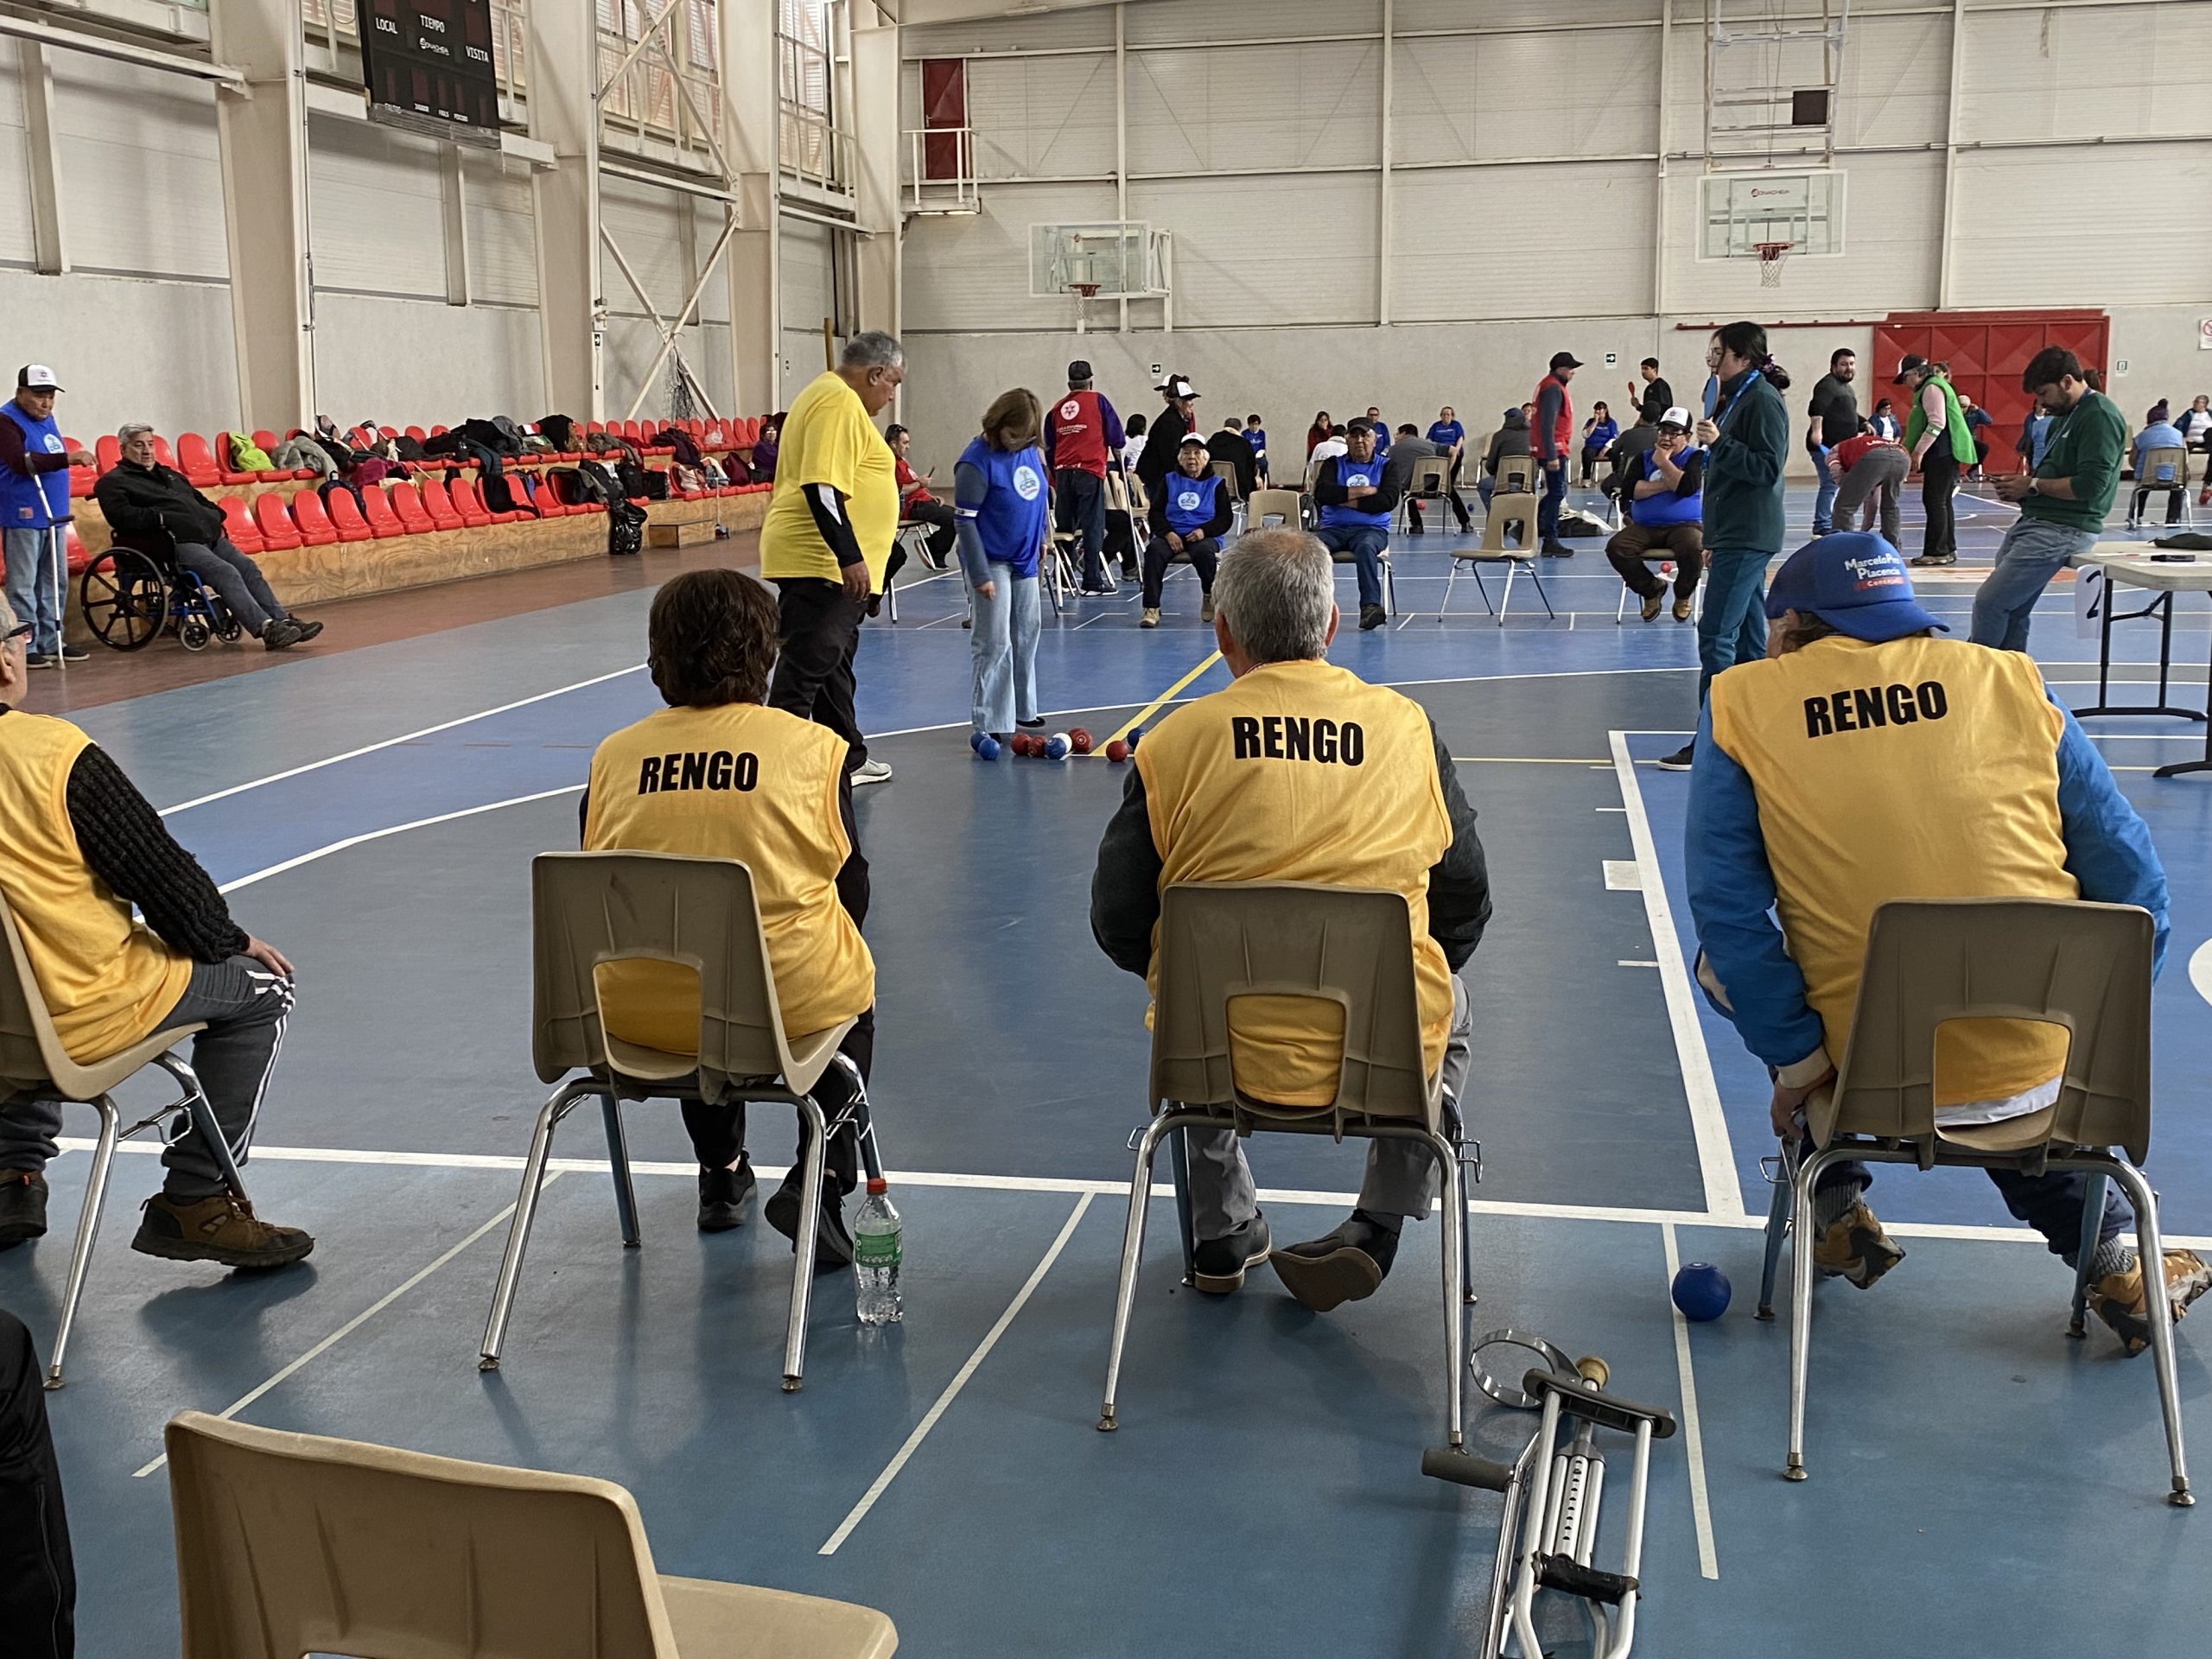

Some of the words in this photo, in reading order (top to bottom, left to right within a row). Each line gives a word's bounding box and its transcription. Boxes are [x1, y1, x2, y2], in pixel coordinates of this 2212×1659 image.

[376, 17, 397, 34] LOCAL
[420, 15, 445, 33] TIEMPO
[466, 45, 489, 63] VISITA
[2086, 570, 2101, 619] 2
[1803, 681, 1948, 739] RENGO
[1231, 716, 1364, 766] RENGO
[638, 751, 759, 795] RENGO
